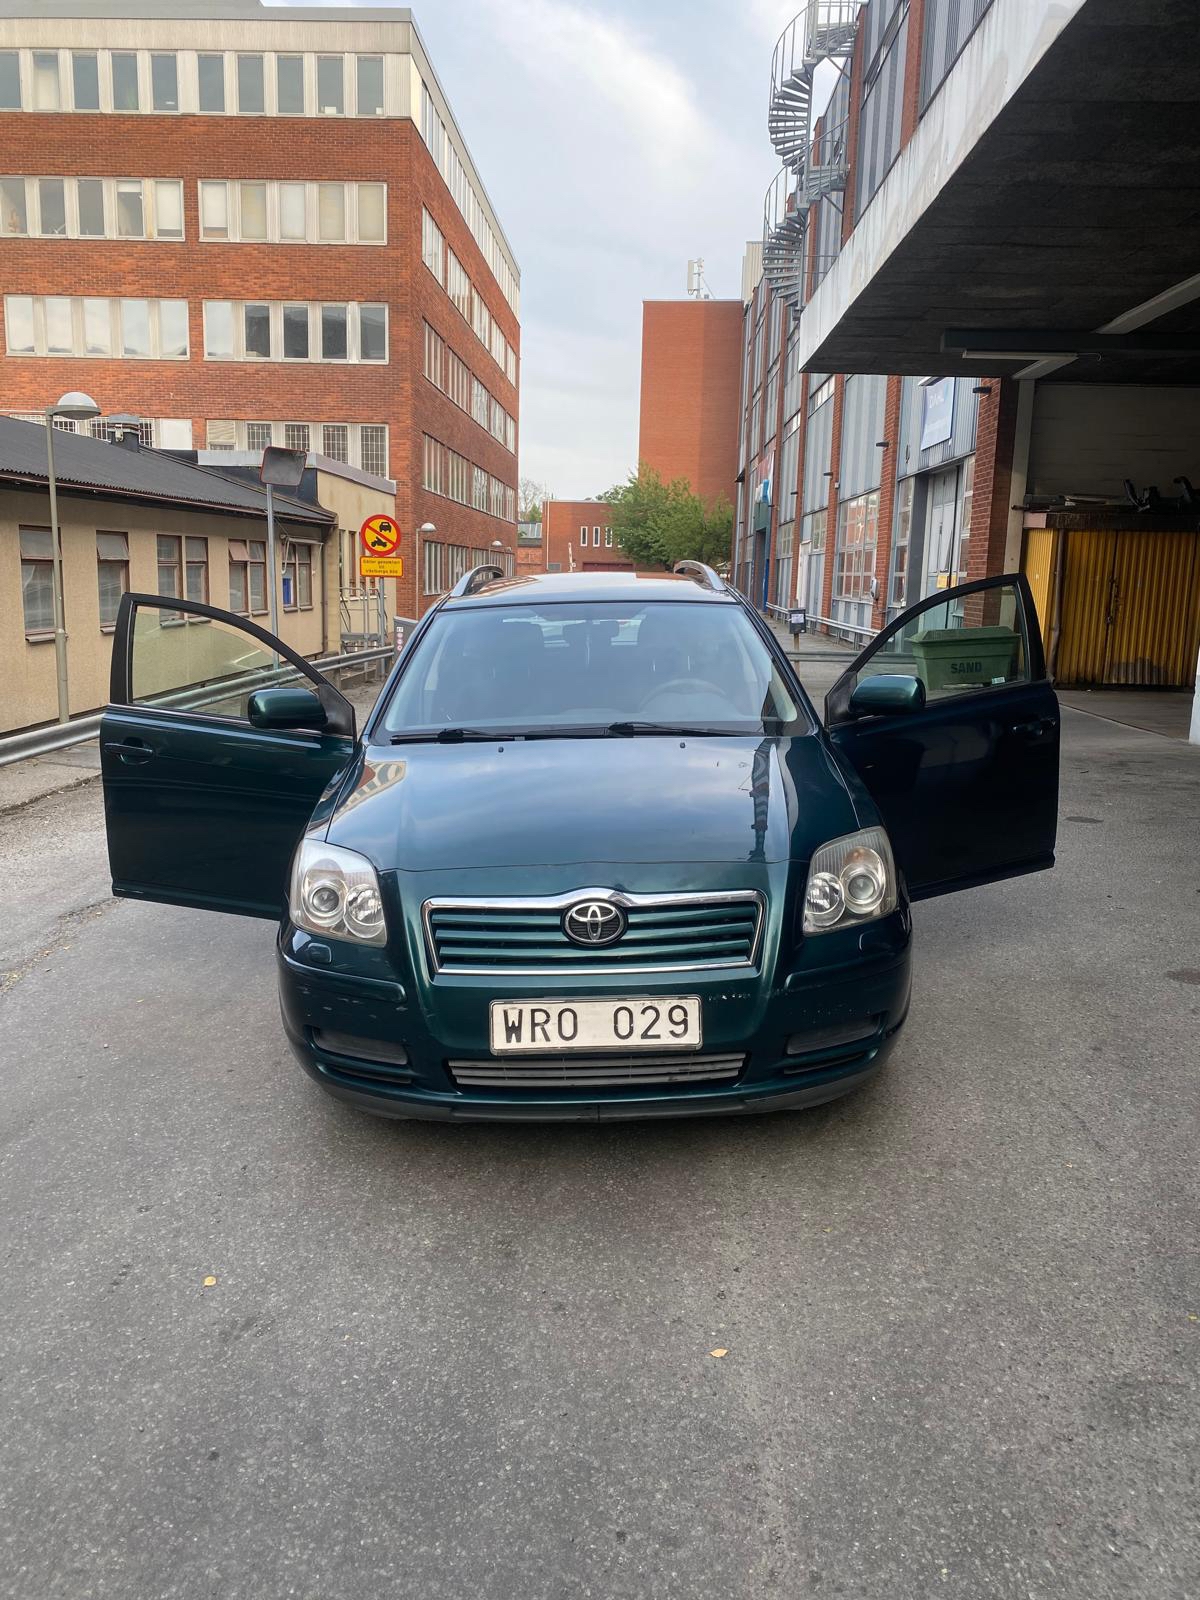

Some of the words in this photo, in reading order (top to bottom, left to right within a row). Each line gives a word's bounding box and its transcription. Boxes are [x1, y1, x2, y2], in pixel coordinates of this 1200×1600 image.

[951, 662, 982, 674] SAND
[503, 1007, 578, 1043] WRO
[613, 1005, 689, 1040] 029
